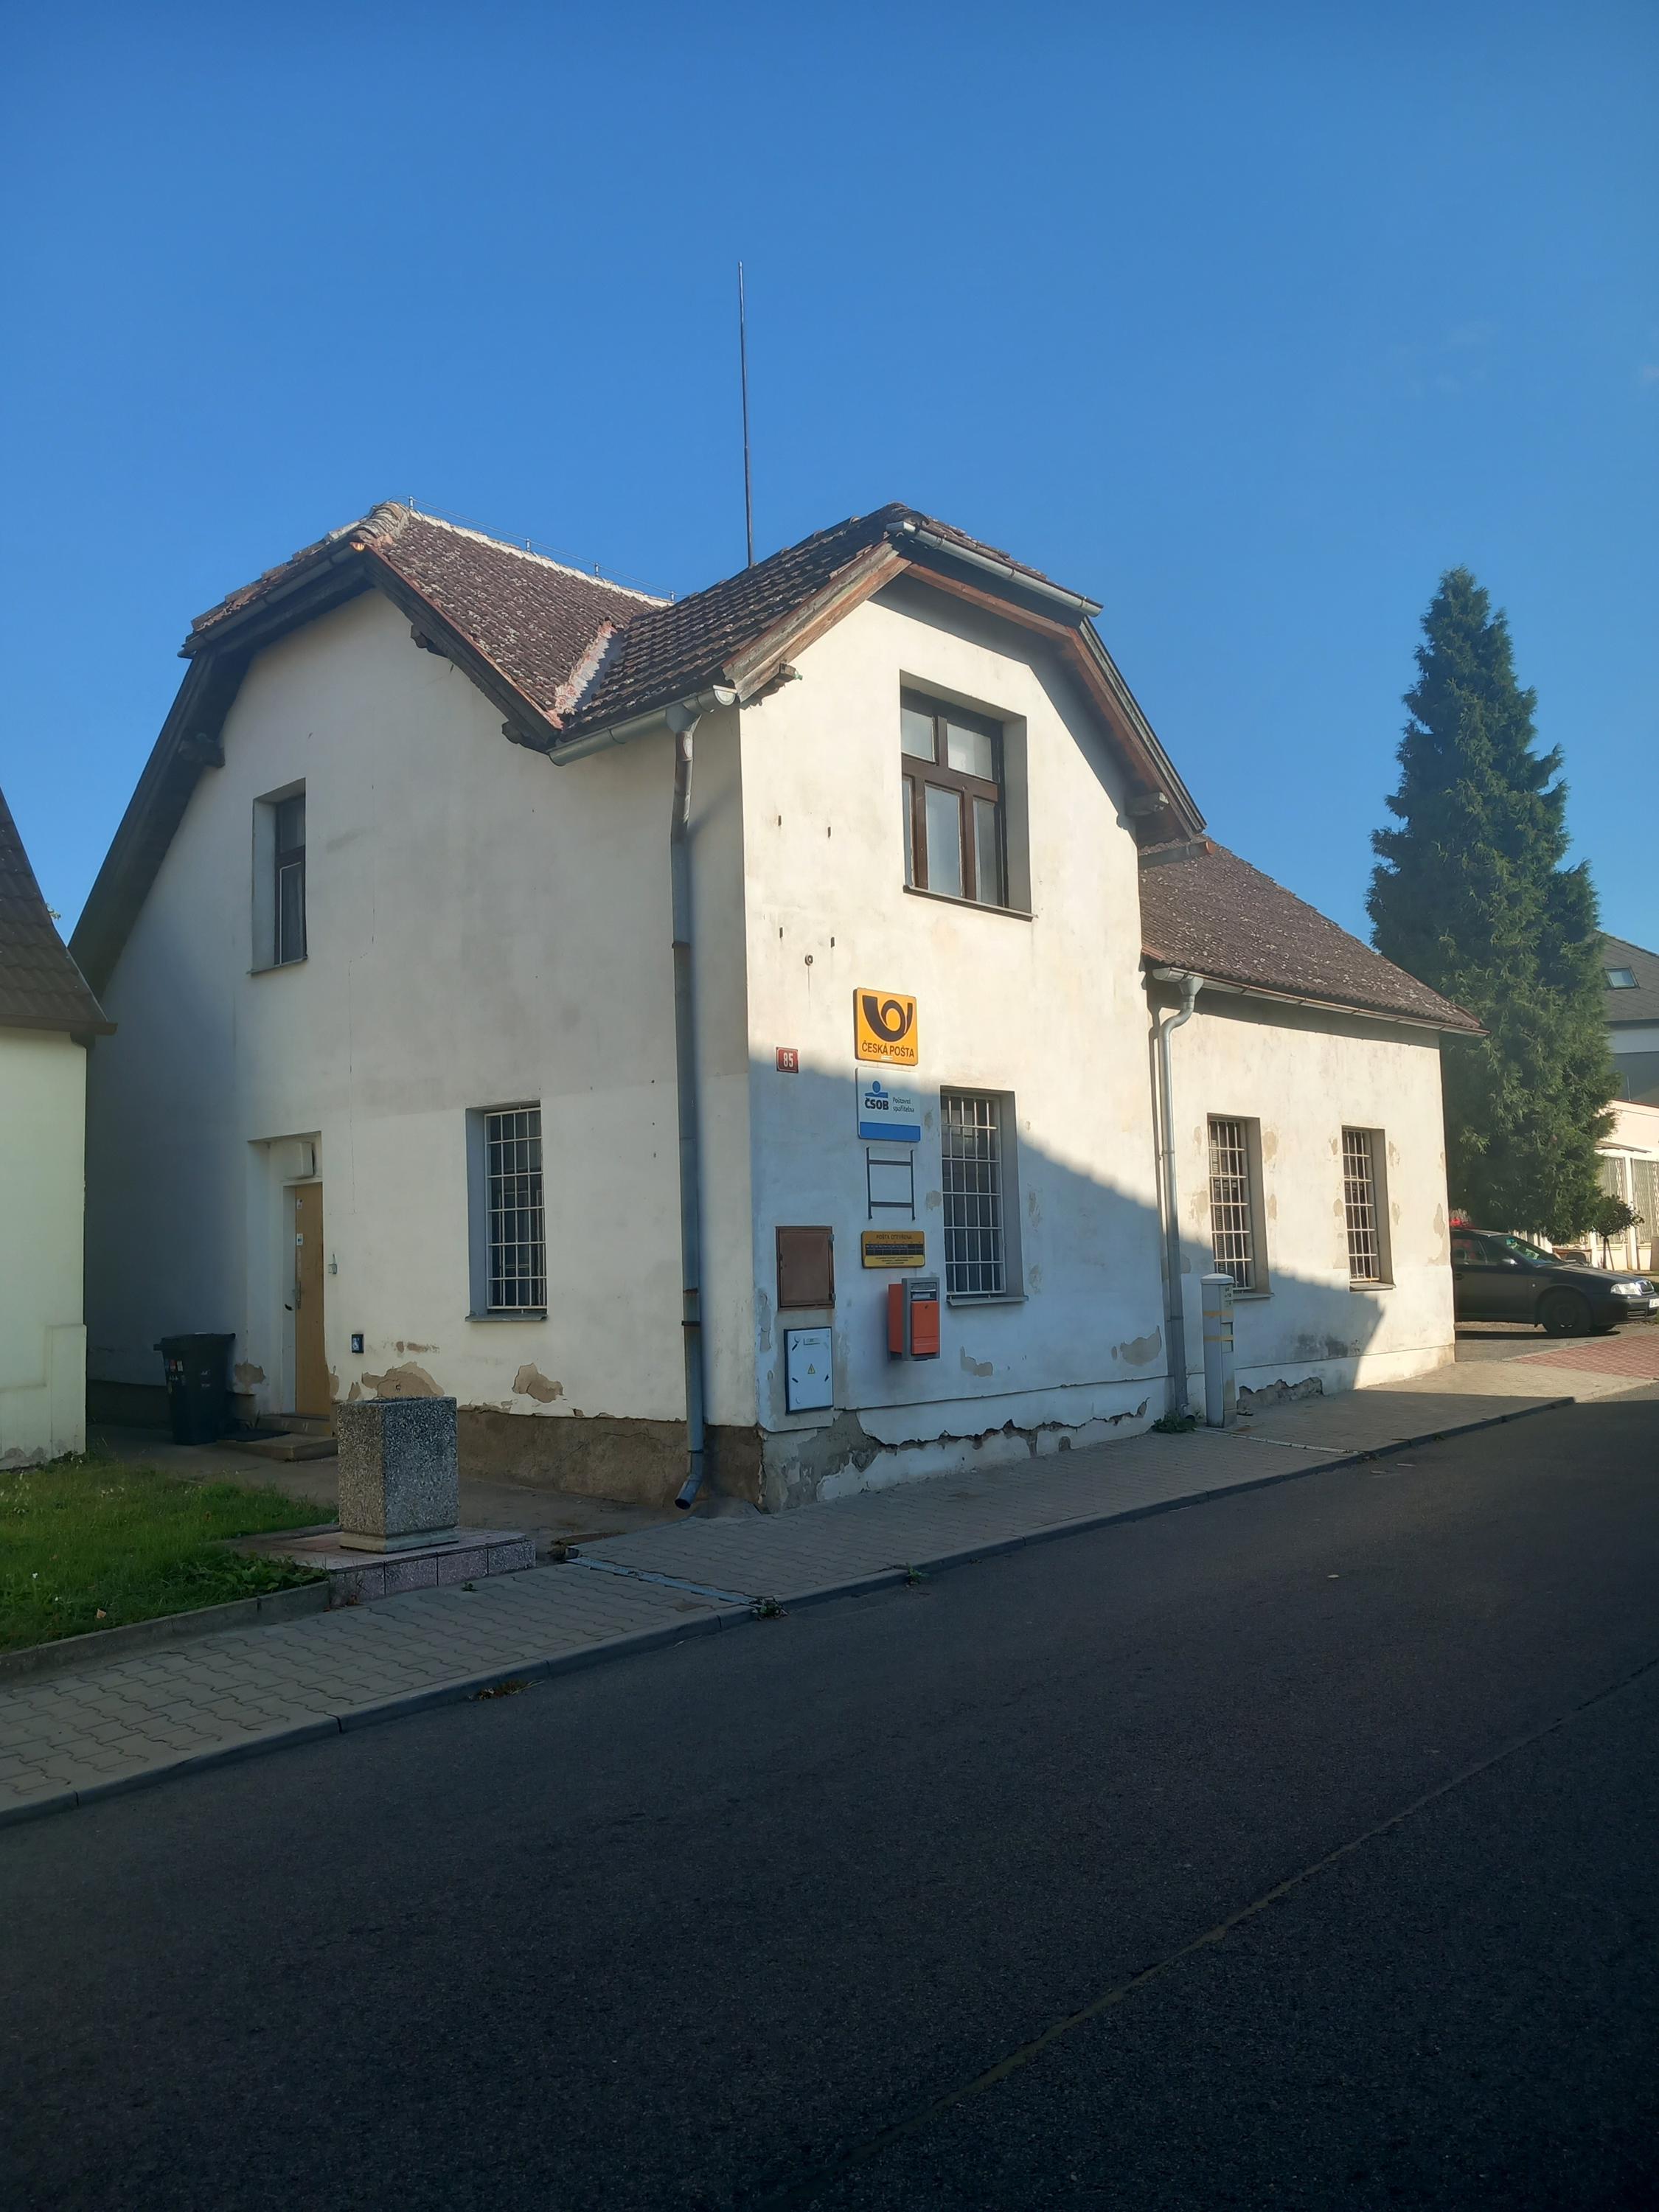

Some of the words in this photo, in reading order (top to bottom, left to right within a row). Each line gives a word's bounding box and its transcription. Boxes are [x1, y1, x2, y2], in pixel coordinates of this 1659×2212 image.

[862, 1040, 888, 1055] ČESKÁ
[889, 1046, 914, 1057] POŠTA
[783, 1052, 793, 1067] 85
[865, 1098, 889, 1110] ČSOB
